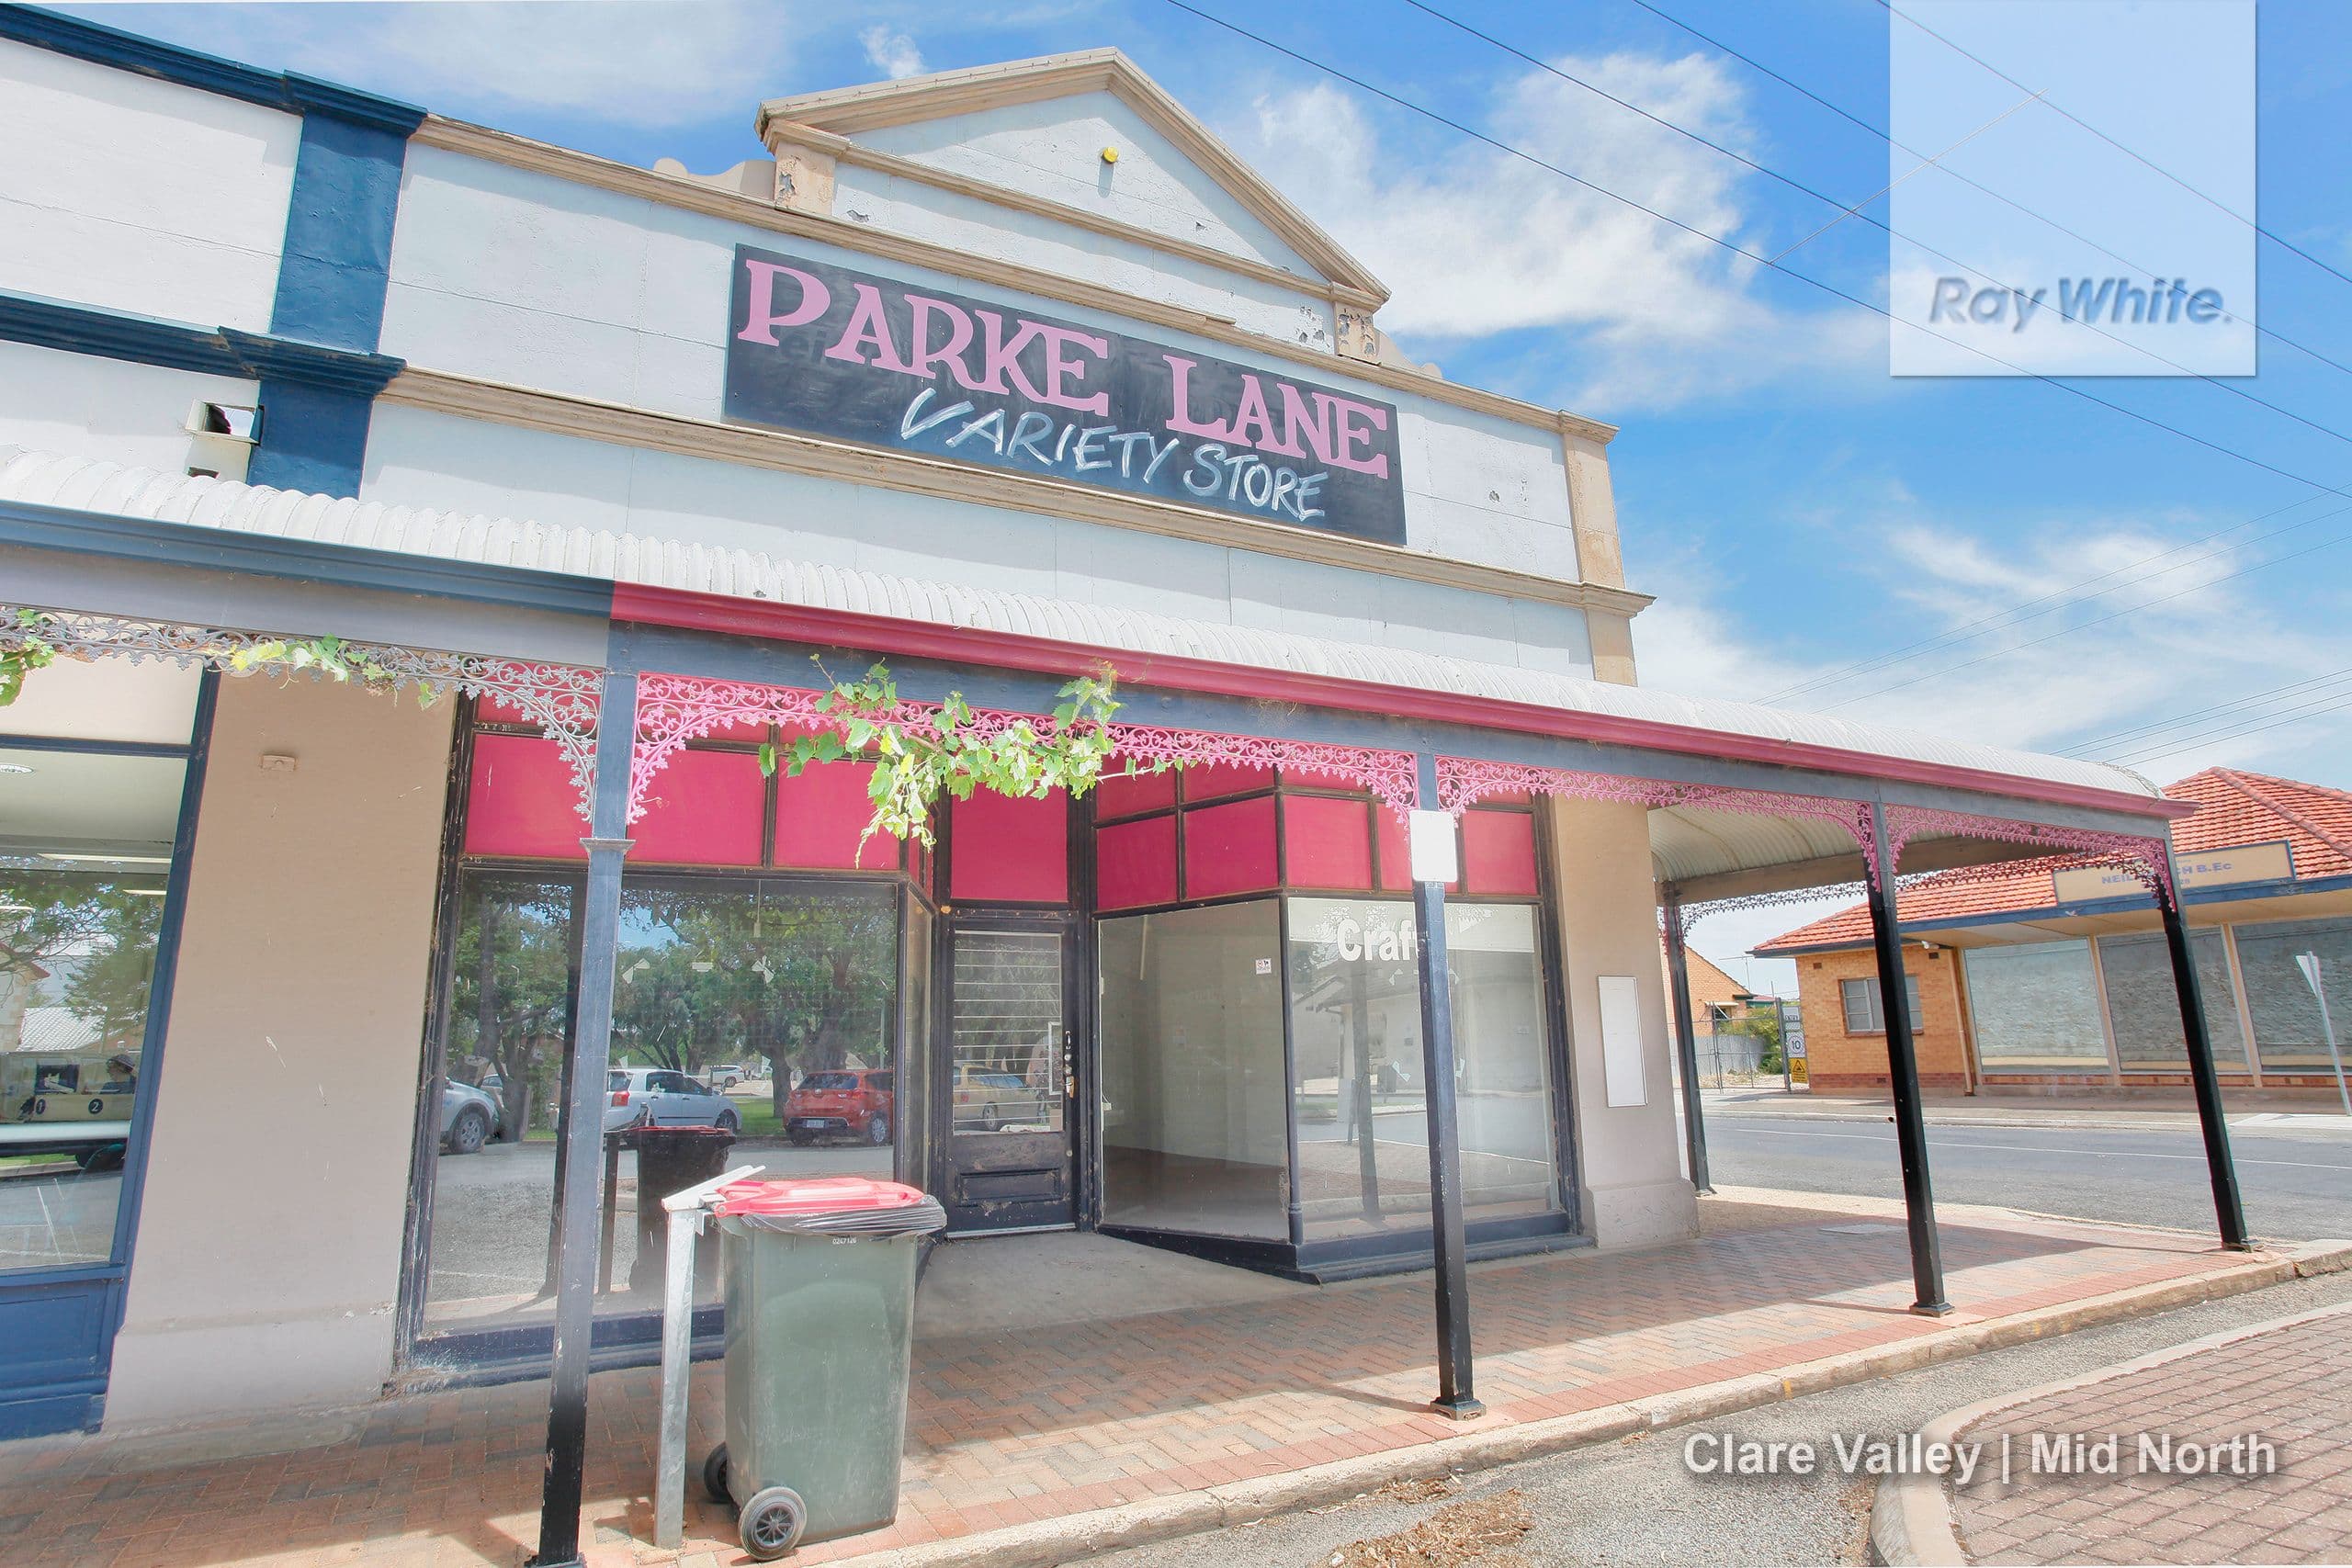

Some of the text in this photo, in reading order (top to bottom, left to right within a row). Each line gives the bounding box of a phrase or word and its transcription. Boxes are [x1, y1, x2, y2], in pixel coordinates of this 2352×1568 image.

[737, 259, 1388, 479] PARKE LANE
[901, 388, 1329, 522] VARIETY STORE
[1792, 1040, 1802, 1050] 10
